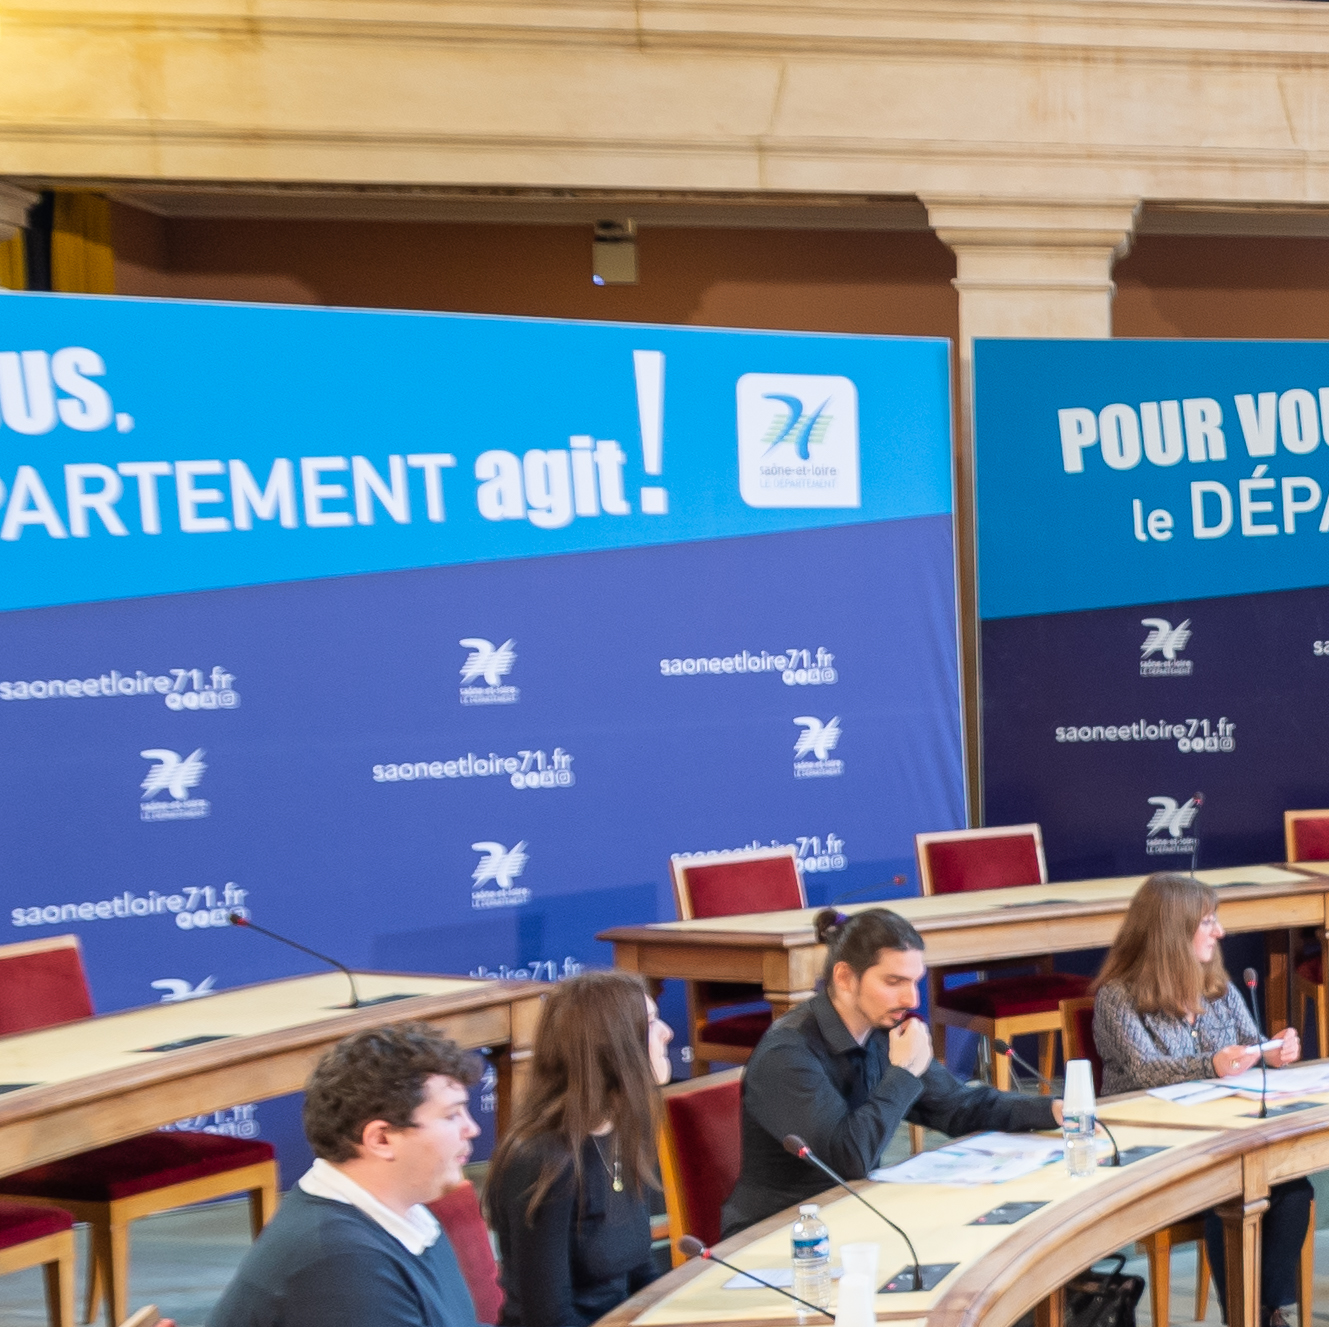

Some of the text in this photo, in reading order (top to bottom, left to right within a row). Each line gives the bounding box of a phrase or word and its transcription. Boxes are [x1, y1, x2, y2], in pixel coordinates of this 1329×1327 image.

[1057, 397, 1227, 473] POUR
[0, 453, 457, 541] ARTEMENT
[1132, 499, 1174, 542] le
[660, 646, 835, 676] saoneetloire71.fr
[0, 666, 236, 700] saoneetloire71.fr
[1055, 717, 1236, 742] saoneetloire71.fr
[373, 748, 575, 782] saoneetloire71.fr
[12, 881, 248, 926] saoneetloire71.fr
